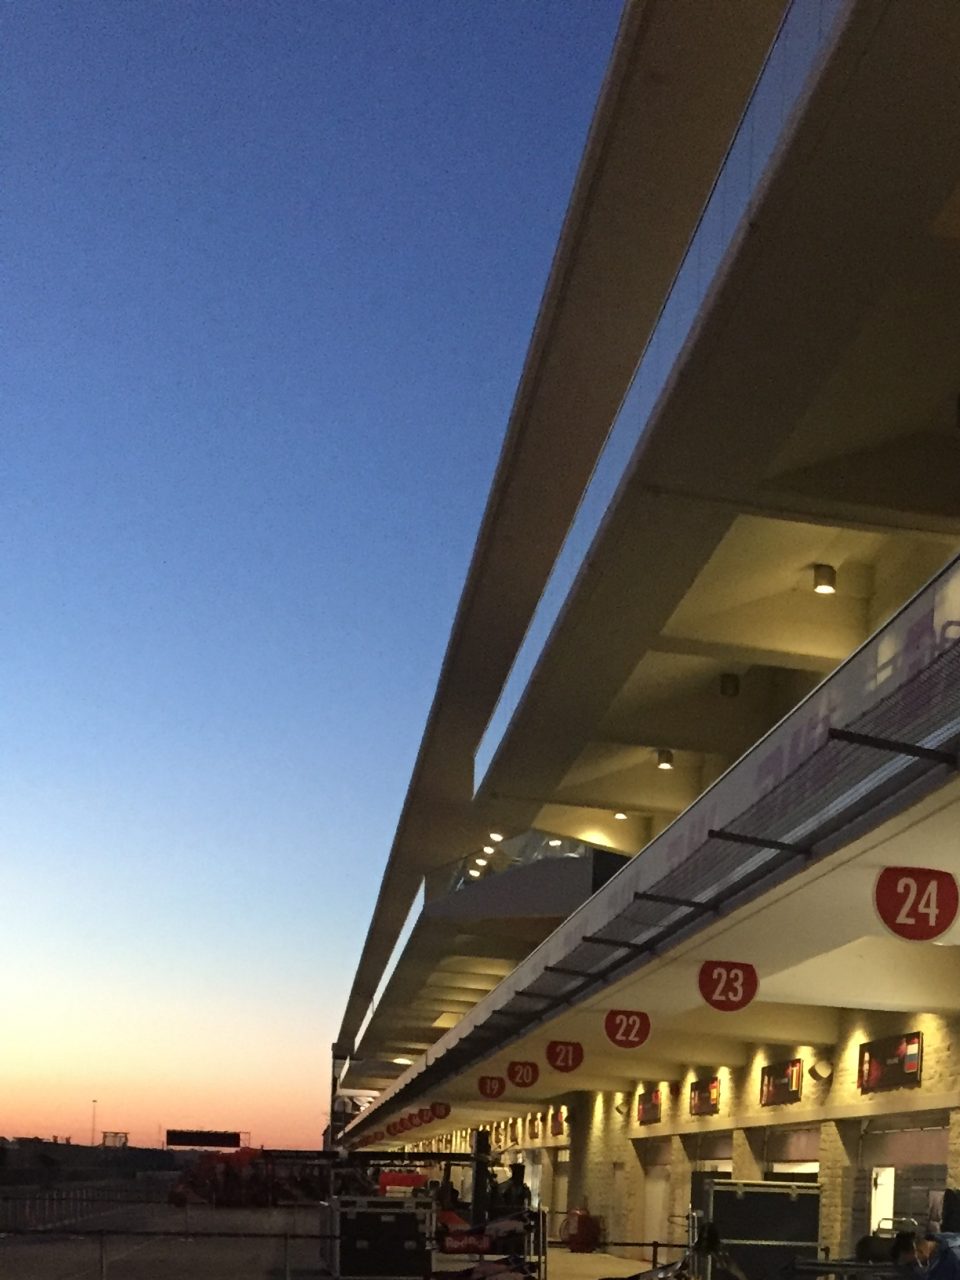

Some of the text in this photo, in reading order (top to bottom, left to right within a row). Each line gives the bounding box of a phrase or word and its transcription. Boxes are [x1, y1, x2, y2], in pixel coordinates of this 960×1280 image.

[896, 877, 940, 927] 24
[712, 967, 744, 1002] 23
[615, 1014, 641, 1042] 22
[556, 1045, 574, 1067] 21
[514, 1065, 533, 1083] 20
[486, 1080, 499, 1095] 19
